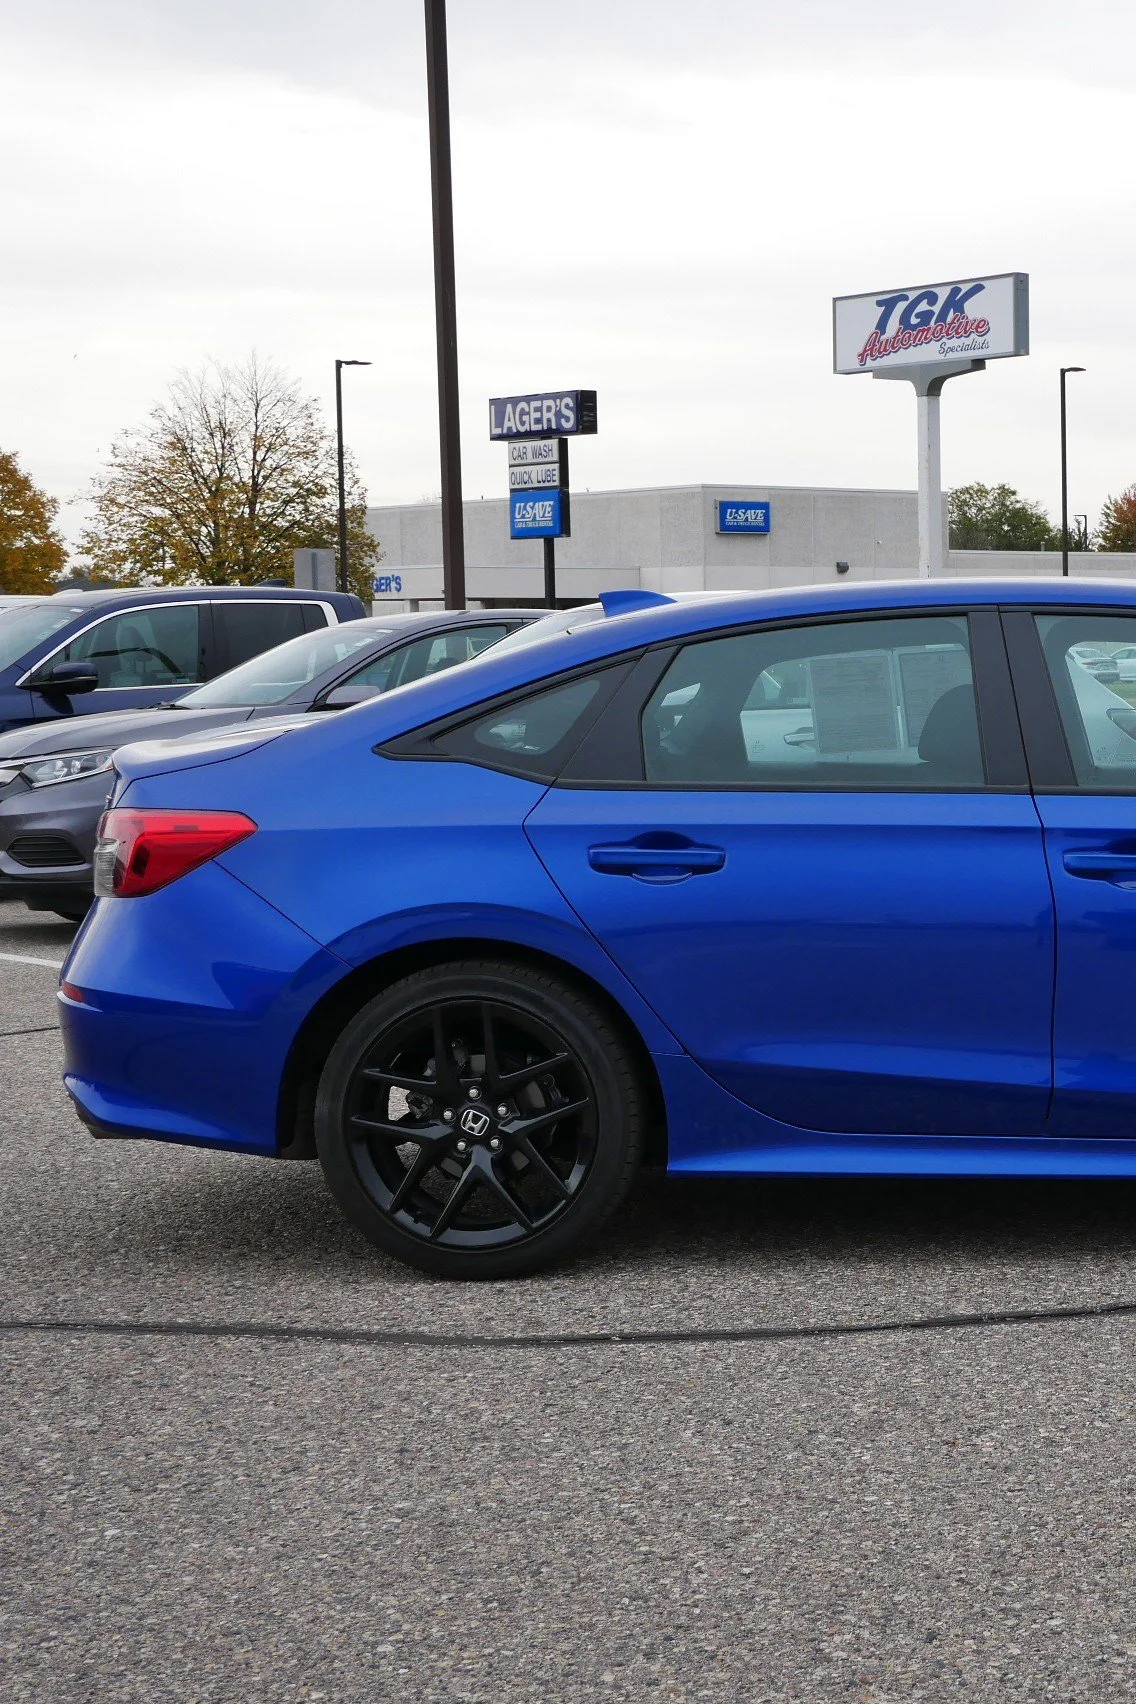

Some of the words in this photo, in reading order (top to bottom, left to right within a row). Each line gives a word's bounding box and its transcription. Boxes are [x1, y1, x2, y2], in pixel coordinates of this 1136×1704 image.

[875, 283, 986, 336] TGK
[857, 312, 991, 366] Automotive
[938, 337, 991, 357] Specialists
[490, 396, 575, 435] LAGER'S
[511, 446, 528, 461] CAR
[531, 443, 554, 460] WASH
[510, 470, 534, 486] QUICK
[536, 468, 557, 484] LUBE
[514, 500, 554, 521] U-SAVE
[725, 508, 766, 521] U-SAVE
[372, 574, 402, 593] GER'S
